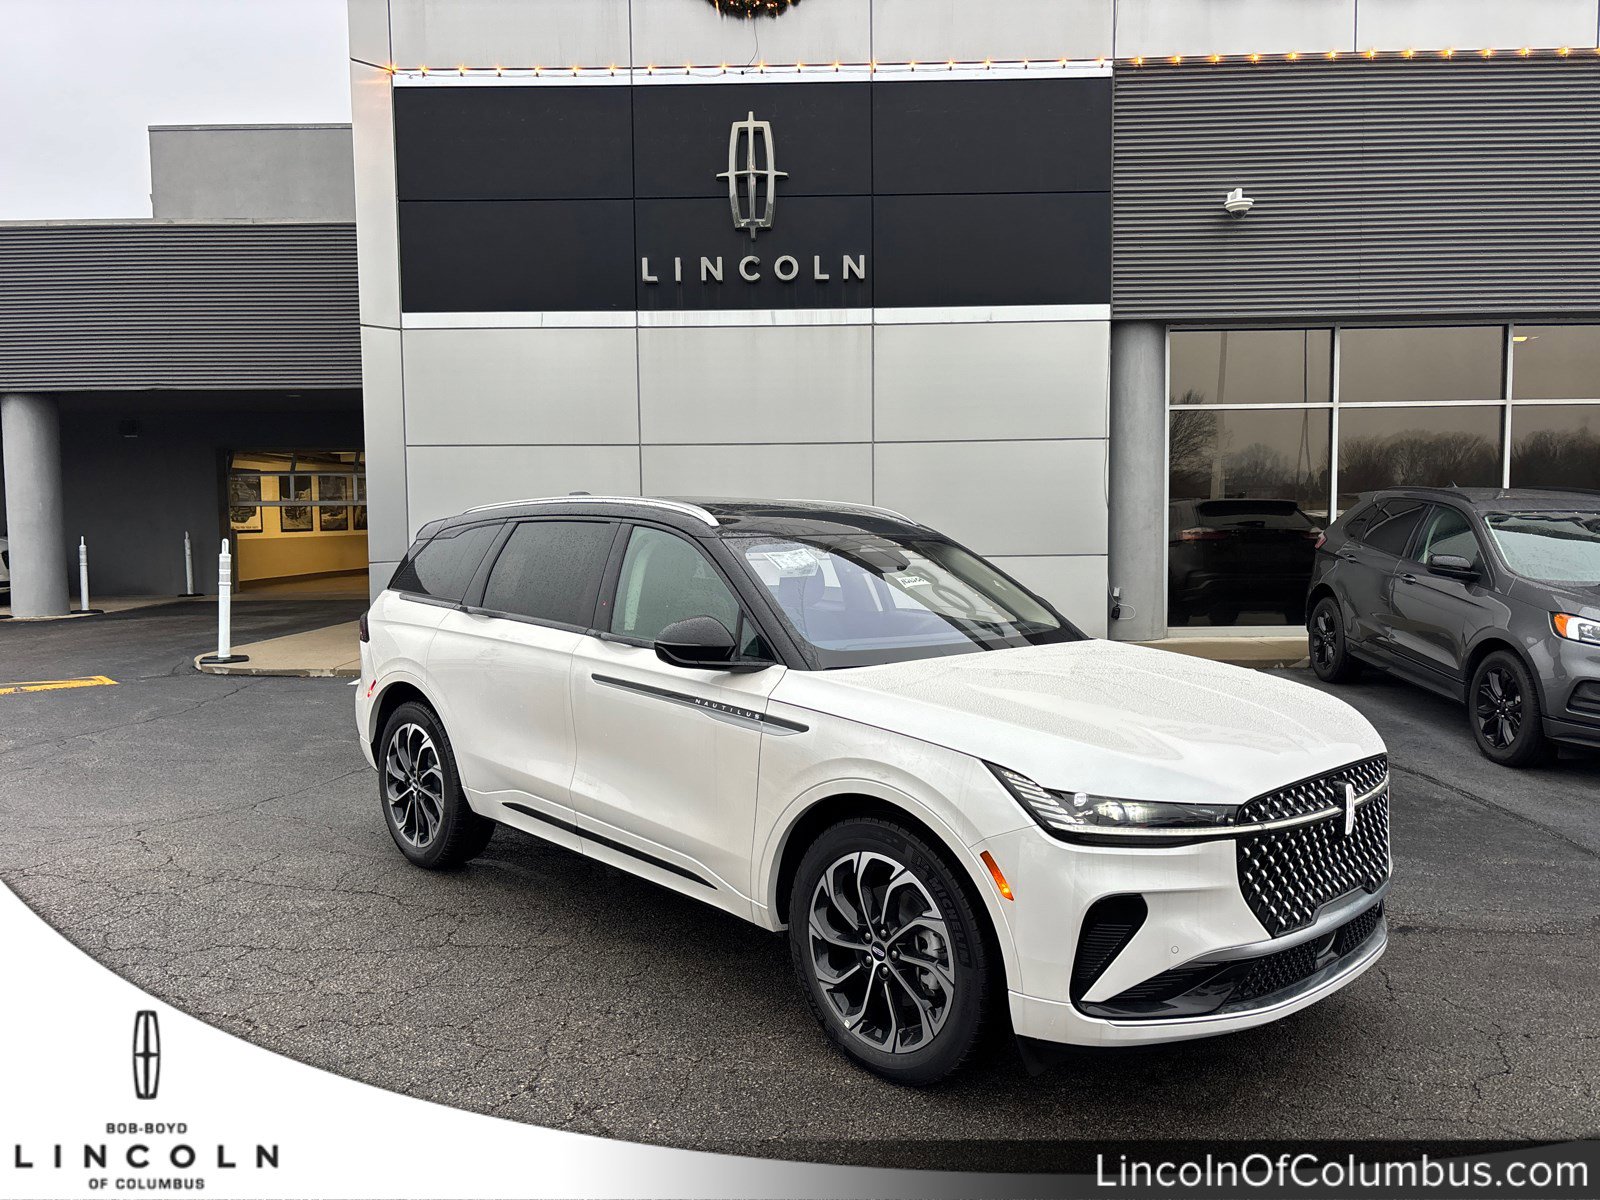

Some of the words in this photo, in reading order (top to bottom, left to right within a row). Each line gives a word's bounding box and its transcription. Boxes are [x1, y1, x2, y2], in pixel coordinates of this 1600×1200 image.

[641, 254, 866, 283] LINCOLN
[694, 698, 760, 720] NAUTILUS
[930, 877, 970, 965] MICHELIN
